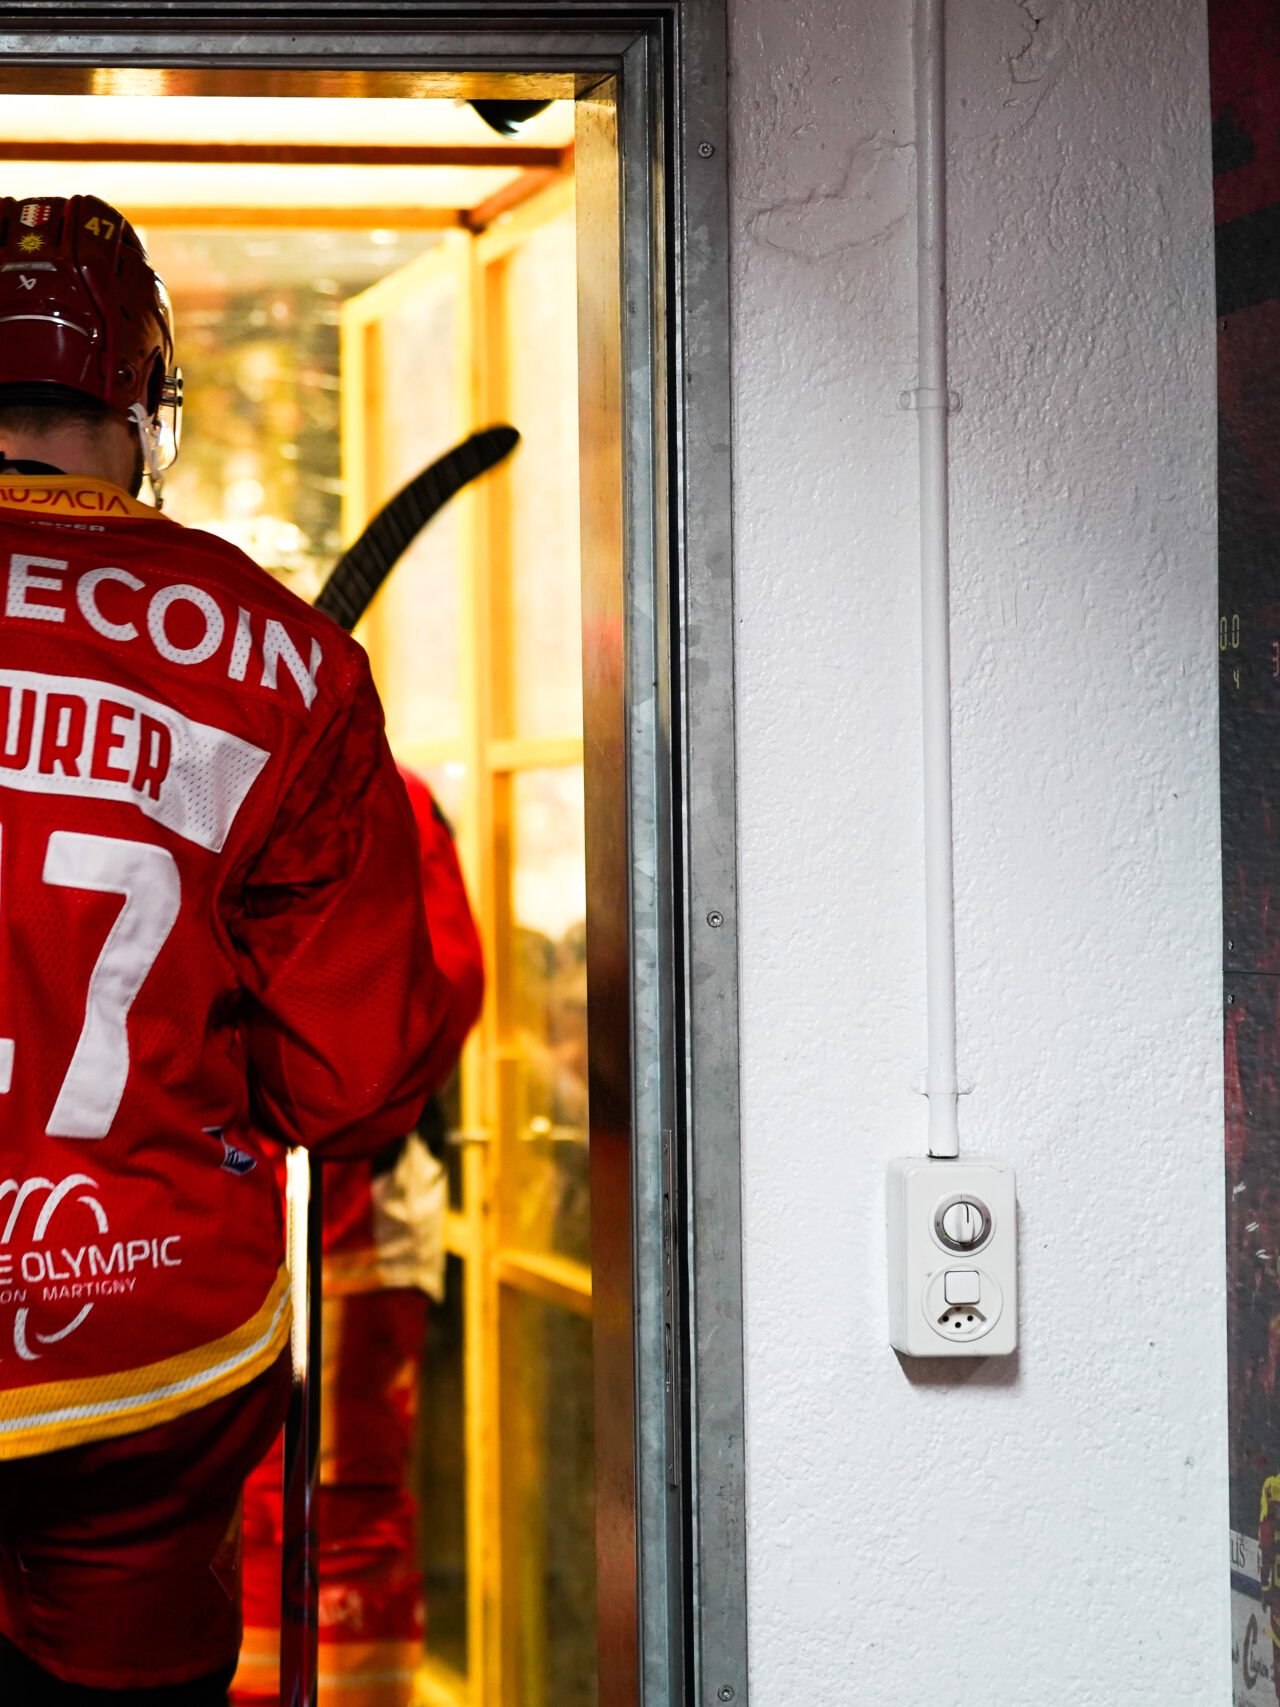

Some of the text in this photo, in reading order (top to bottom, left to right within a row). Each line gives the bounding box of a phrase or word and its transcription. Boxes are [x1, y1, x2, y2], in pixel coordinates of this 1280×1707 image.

[84, 216, 116, 241] 47
[21, 1235, 183, 1284] OLYMPIC
[42, 1277, 138, 1303] MARTIGNY
